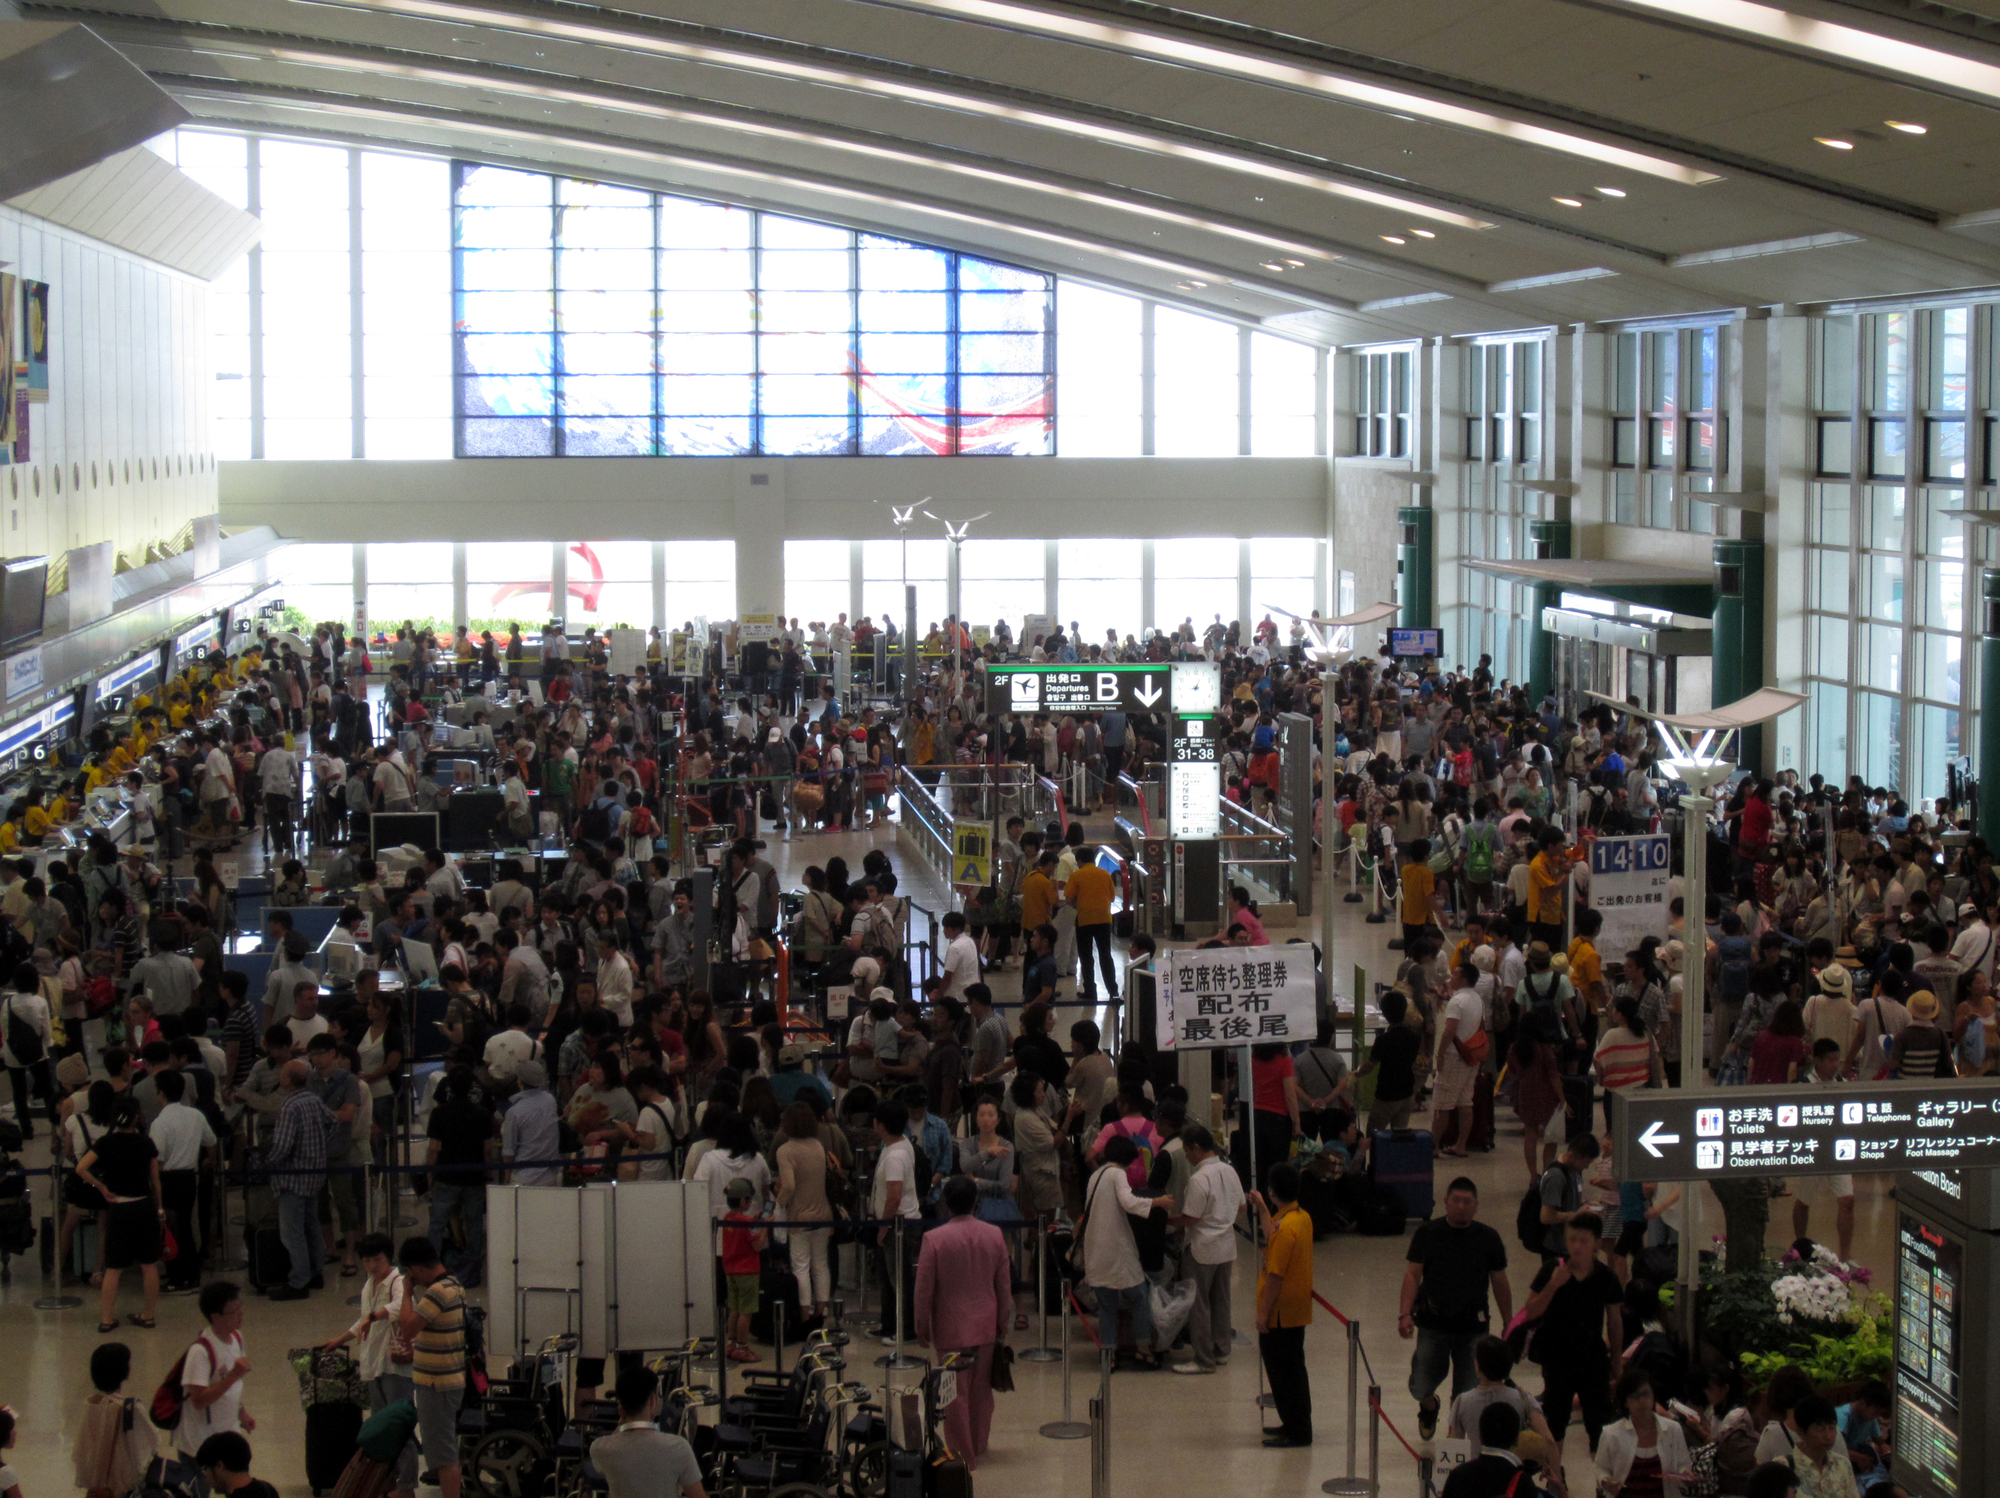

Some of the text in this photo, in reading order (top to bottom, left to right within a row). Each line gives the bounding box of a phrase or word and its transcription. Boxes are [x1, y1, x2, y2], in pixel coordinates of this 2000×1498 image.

[276, 601, 284, 610] 11
[264, 607, 273, 617] 10
[242, 621, 250, 631] 9
[197, 647, 205, 659] 8
[994, 675, 1009, 686] 2F
[1046, 673, 1081, 683] 出発口
[1045, 684, 1089, 693] Departures
[1096, 672, 1119, 701] B
[113, 697, 122, 711] 7
[1173, 738, 1187, 748] 2F
[33, 744, 45, 760] 6
[1177, 748, 1215, 760] 31-38
[1597, 842, 1667, 870] 14:10
[960, 862, 982, 882] A
[1597, 892, 1663, 906] ご出発のお客様
[1178, 960, 1288, 993] 空席待ち整理券
[1196, 991, 1273, 1016] 配布
[1181, 1013, 1289, 1042] 最後尾
[1802, 1105, 1835, 1117] 授乳室
[1866, 1102, 1893, 1114] 電話
[1728, 1107, 1774, 1122] お手洗
[1866, 1113, 1911, 1123] Telephones
[1802, 1117, 1834, 1126] Nursery
[1917, 1117, 1955, 1128] Gallery
[1729, 1124, 1766, 1135] Toilets
[1729, 1139, 1820, 1156] 見学者デッキ
[1860, 1138, 1899, 1150] ショップ
[1860, 1151, 1885, 1160] Shops
[1906, 1148, 1960, 1158] Foot Massage
[1730, 1154, 1815, 1167] Observation Deck
[1940, 1171, 1961, 1200] Board
[1440, 1451, 1465, 1463] 入口
